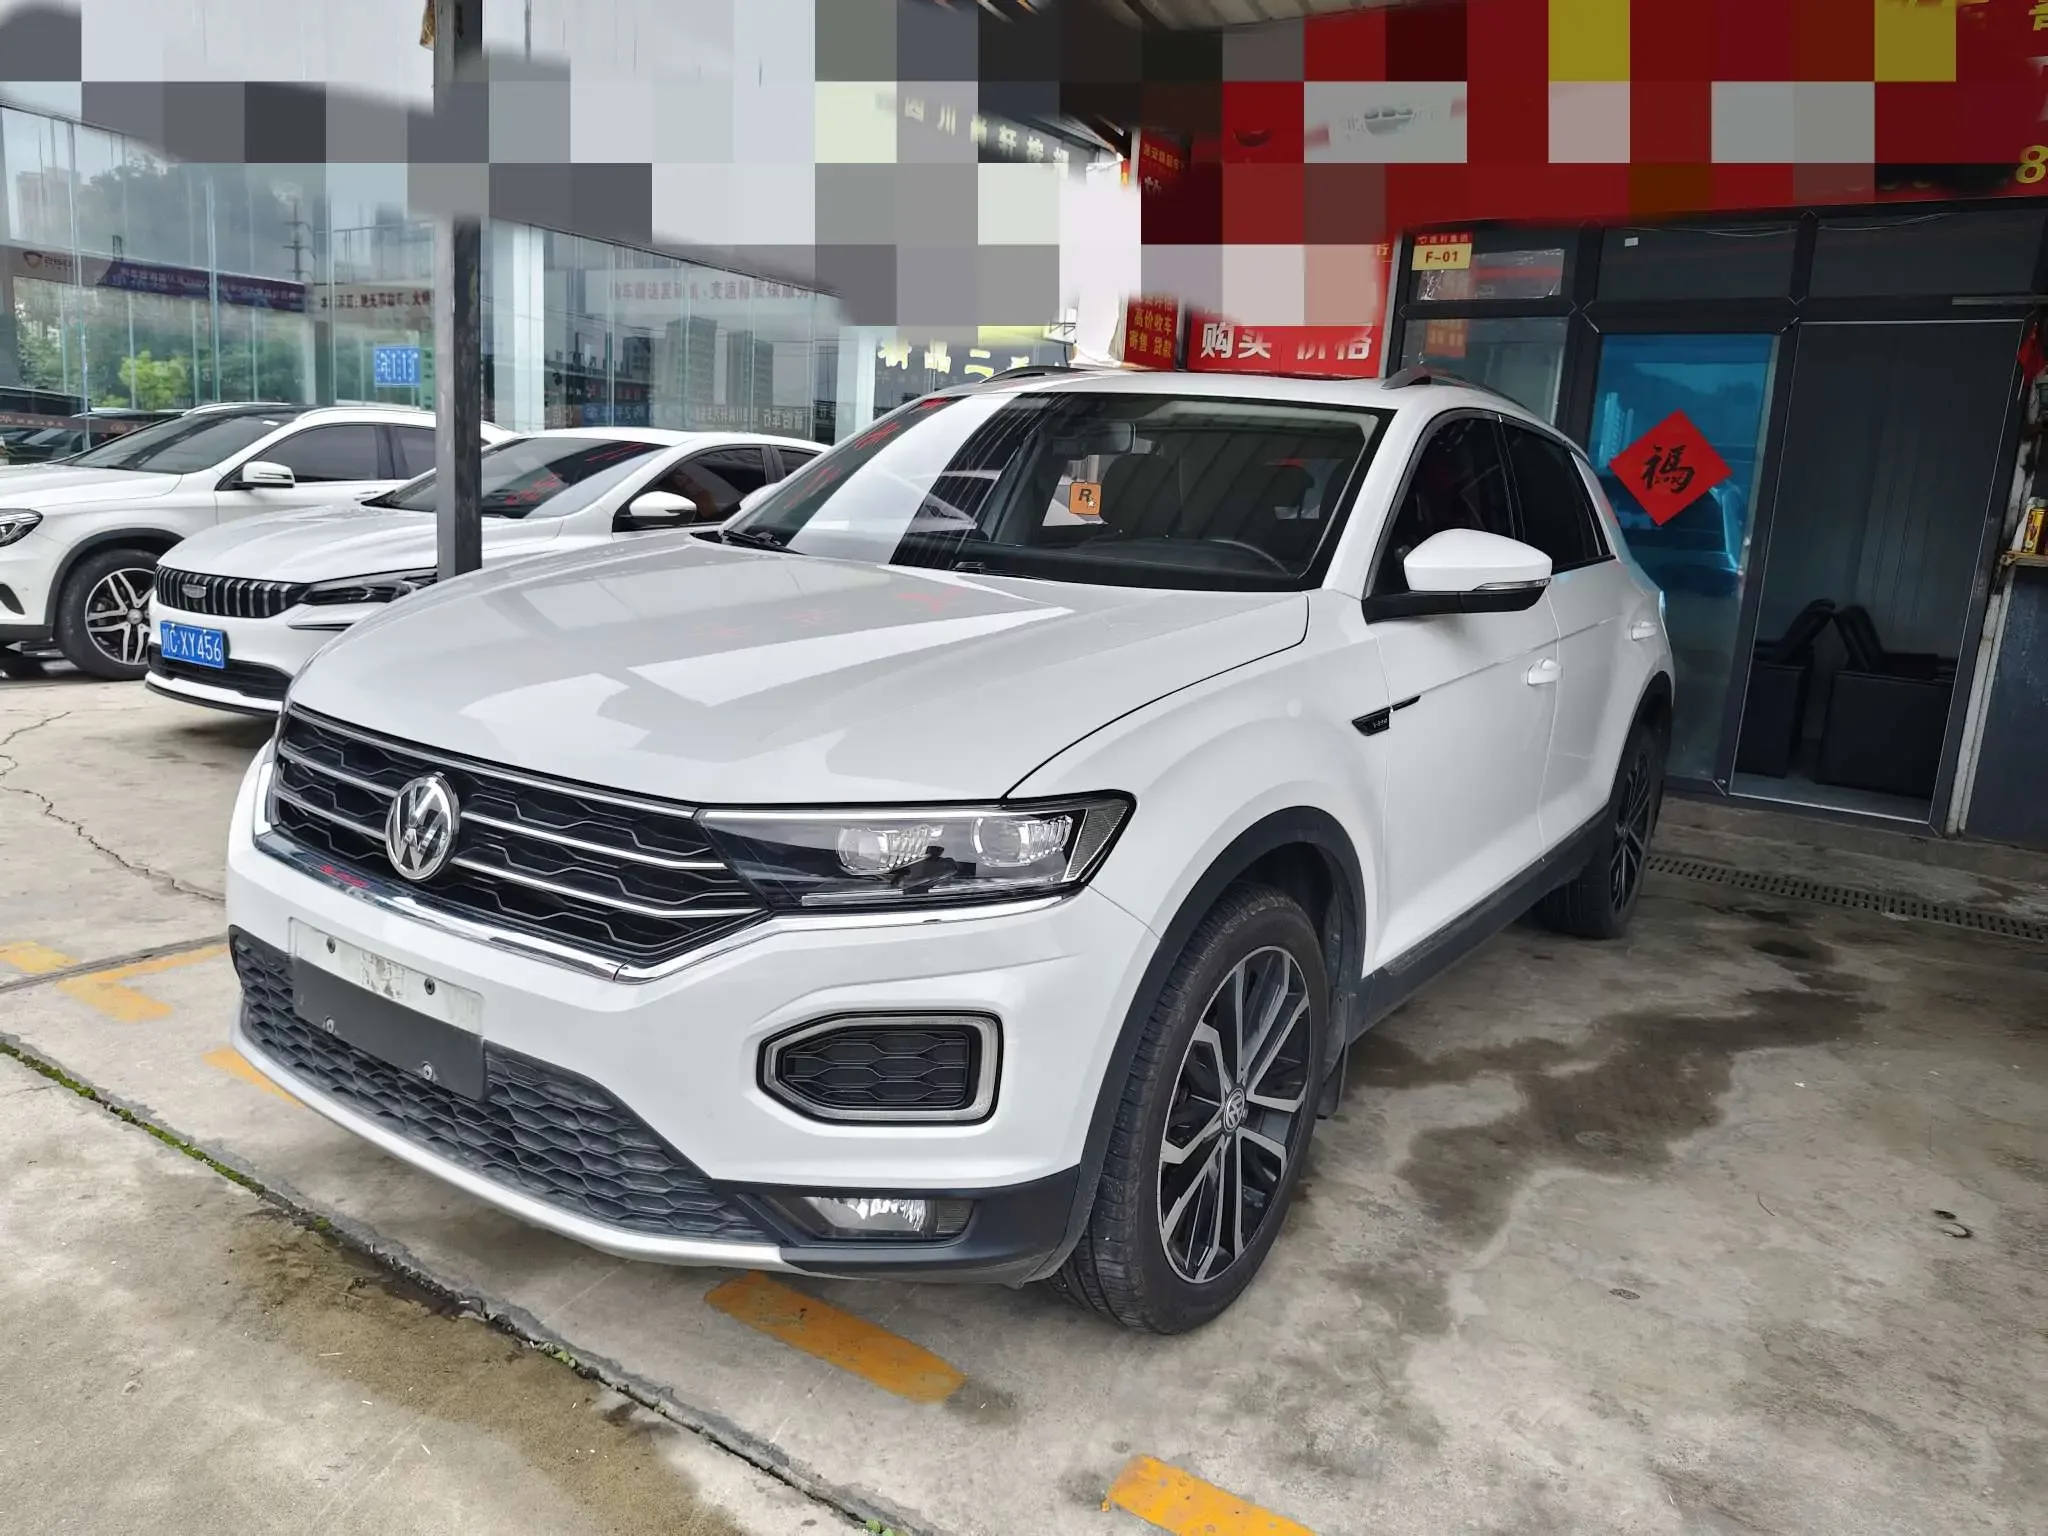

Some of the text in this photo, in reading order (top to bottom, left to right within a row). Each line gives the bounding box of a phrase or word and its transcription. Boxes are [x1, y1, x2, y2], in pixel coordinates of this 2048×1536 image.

[1425, 251, 1459, 263] F-01
[1134, 308, 1173, 335] 高价收车
